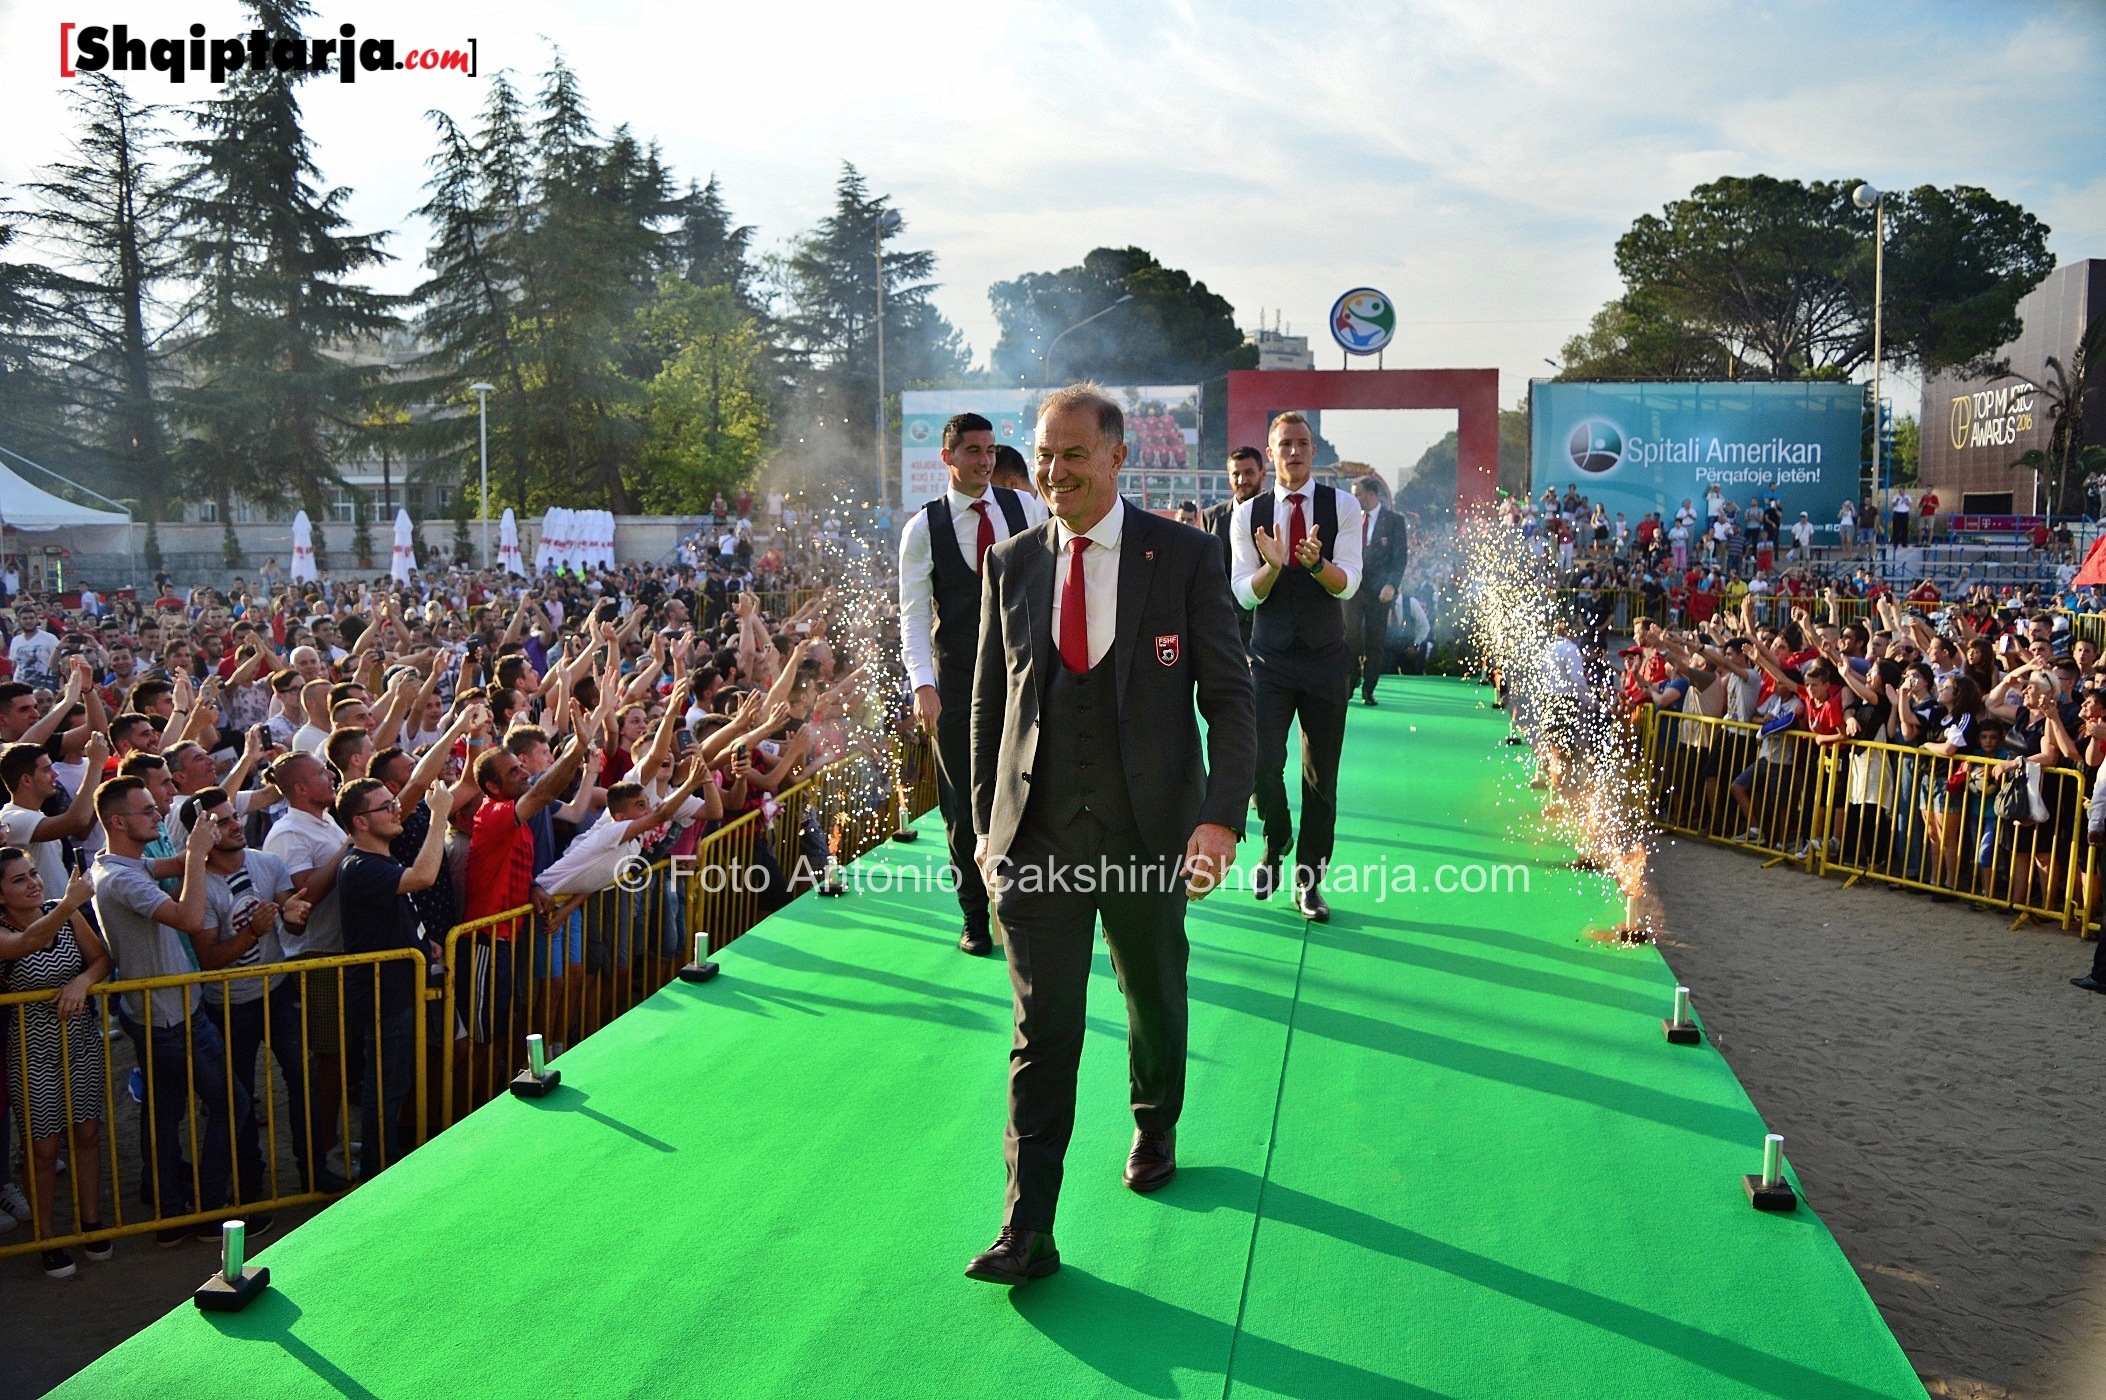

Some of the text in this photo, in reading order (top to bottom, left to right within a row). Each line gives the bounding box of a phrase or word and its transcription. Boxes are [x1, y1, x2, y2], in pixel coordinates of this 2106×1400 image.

[1972, 390, 1995, 419] TOP
[1970, 412, 2033, 448] AWARDS 2016
[1627, 437, 1822, 467] Spitali Amerikan
[1695, 466, 1821, 486] Përqafoje jetën!
